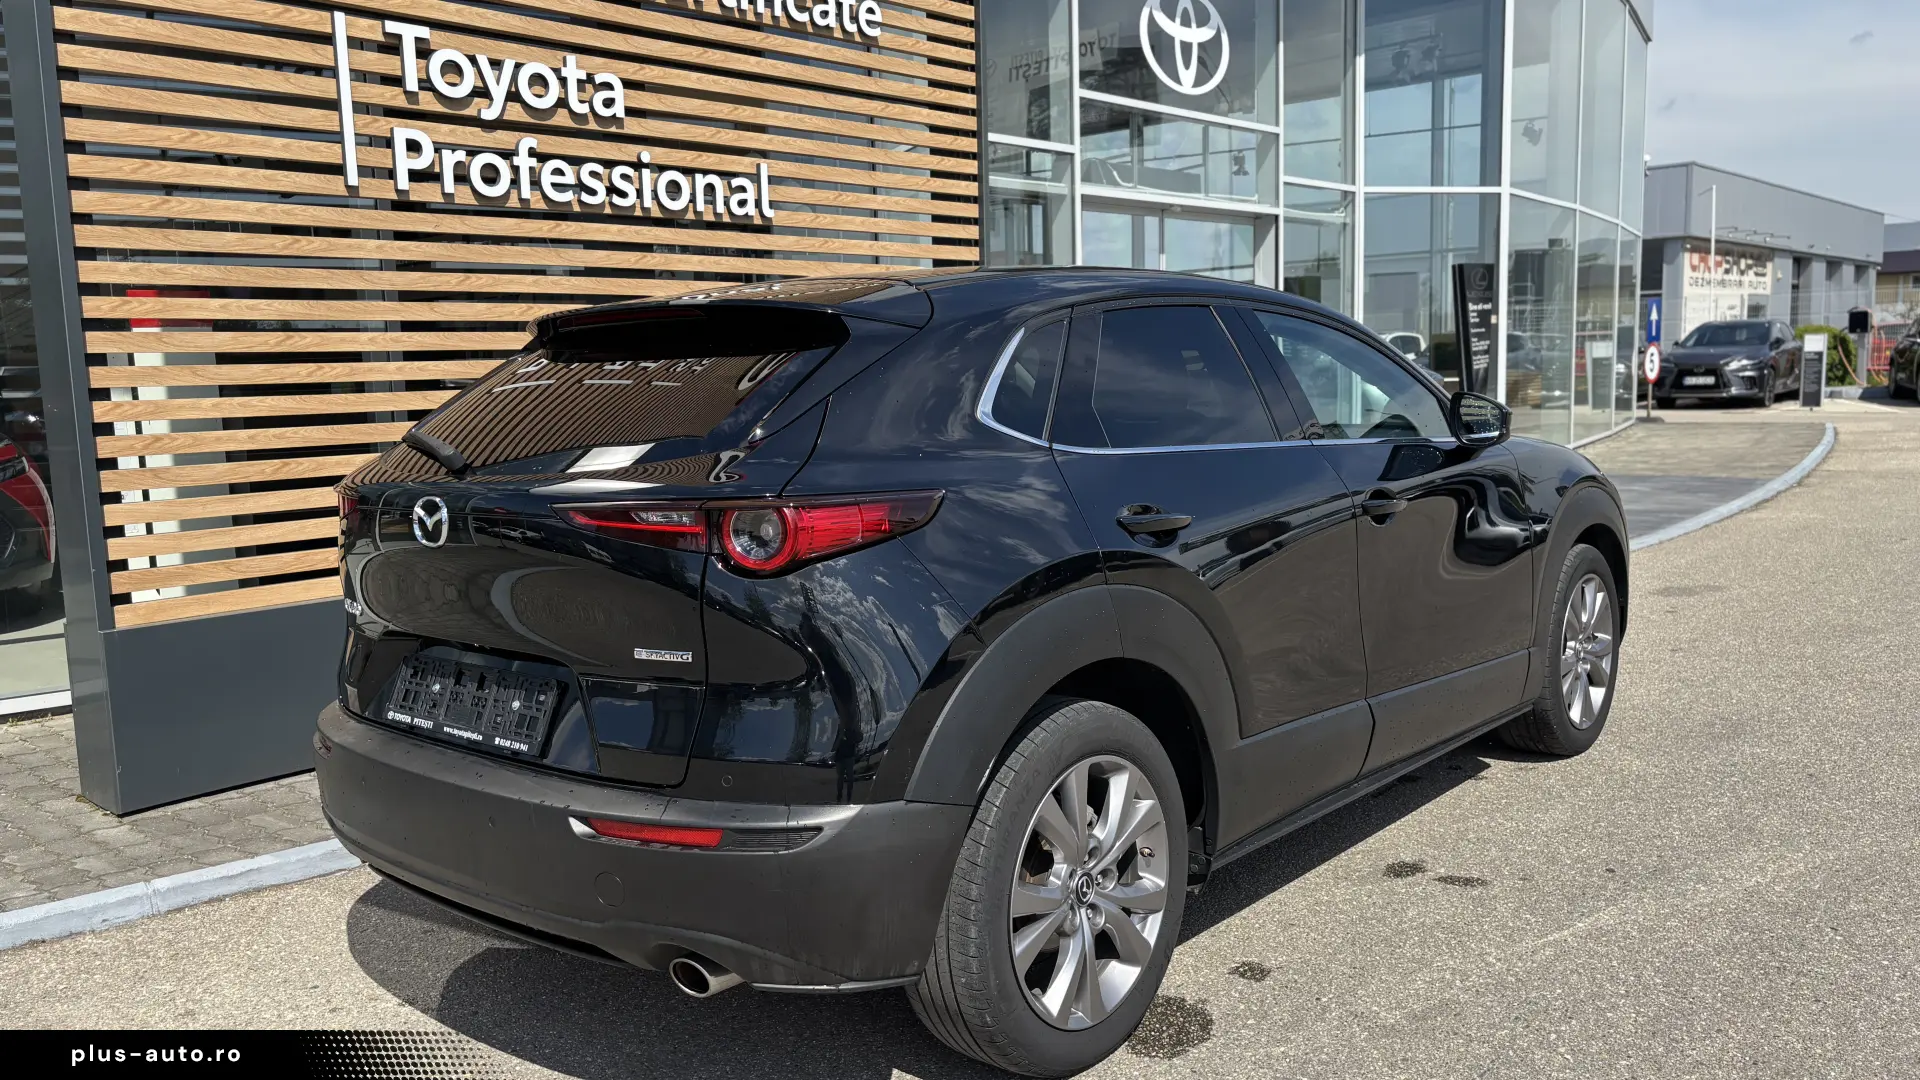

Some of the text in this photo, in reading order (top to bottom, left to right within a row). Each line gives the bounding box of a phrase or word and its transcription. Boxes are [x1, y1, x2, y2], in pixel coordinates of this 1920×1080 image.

[384, 20, 625, 120] Toyota
[391, 127, 775, 218] Professional
[1649, 352, 1655, 373] 5
[394, 710, 411, 724] TOYOTA
